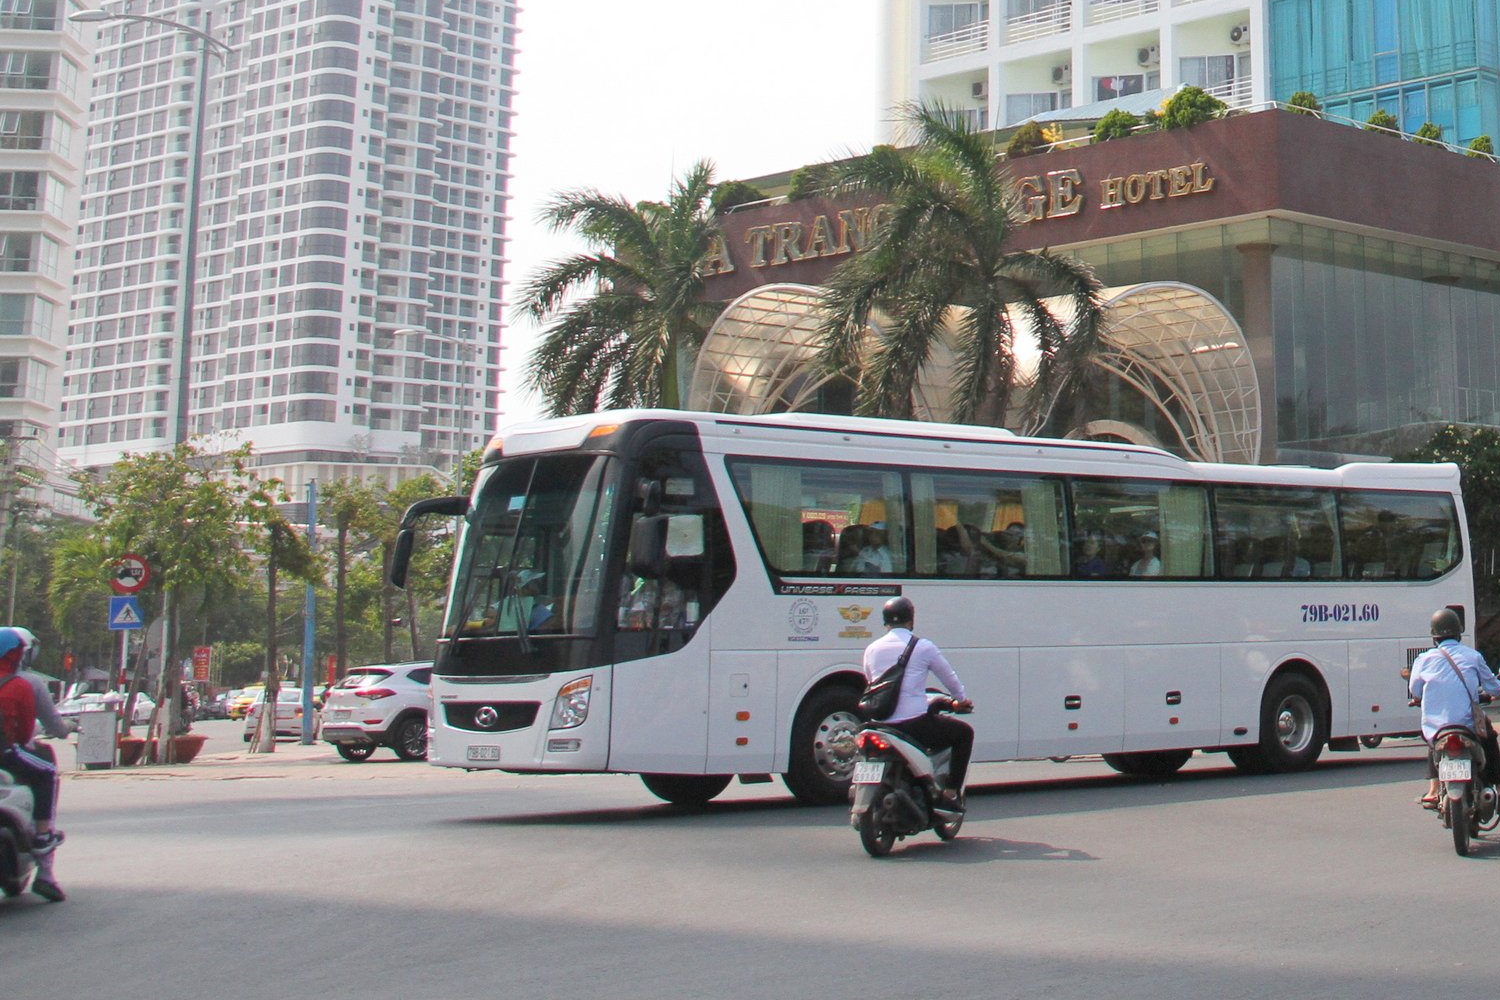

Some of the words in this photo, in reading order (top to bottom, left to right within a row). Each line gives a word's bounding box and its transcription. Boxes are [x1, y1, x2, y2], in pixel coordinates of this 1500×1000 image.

[1099, 161, 1216, 210] HOTEL
[780, 585, 835, 594] UNIVERSE
[1300, 603, 1379, 623] 79B-021.60
